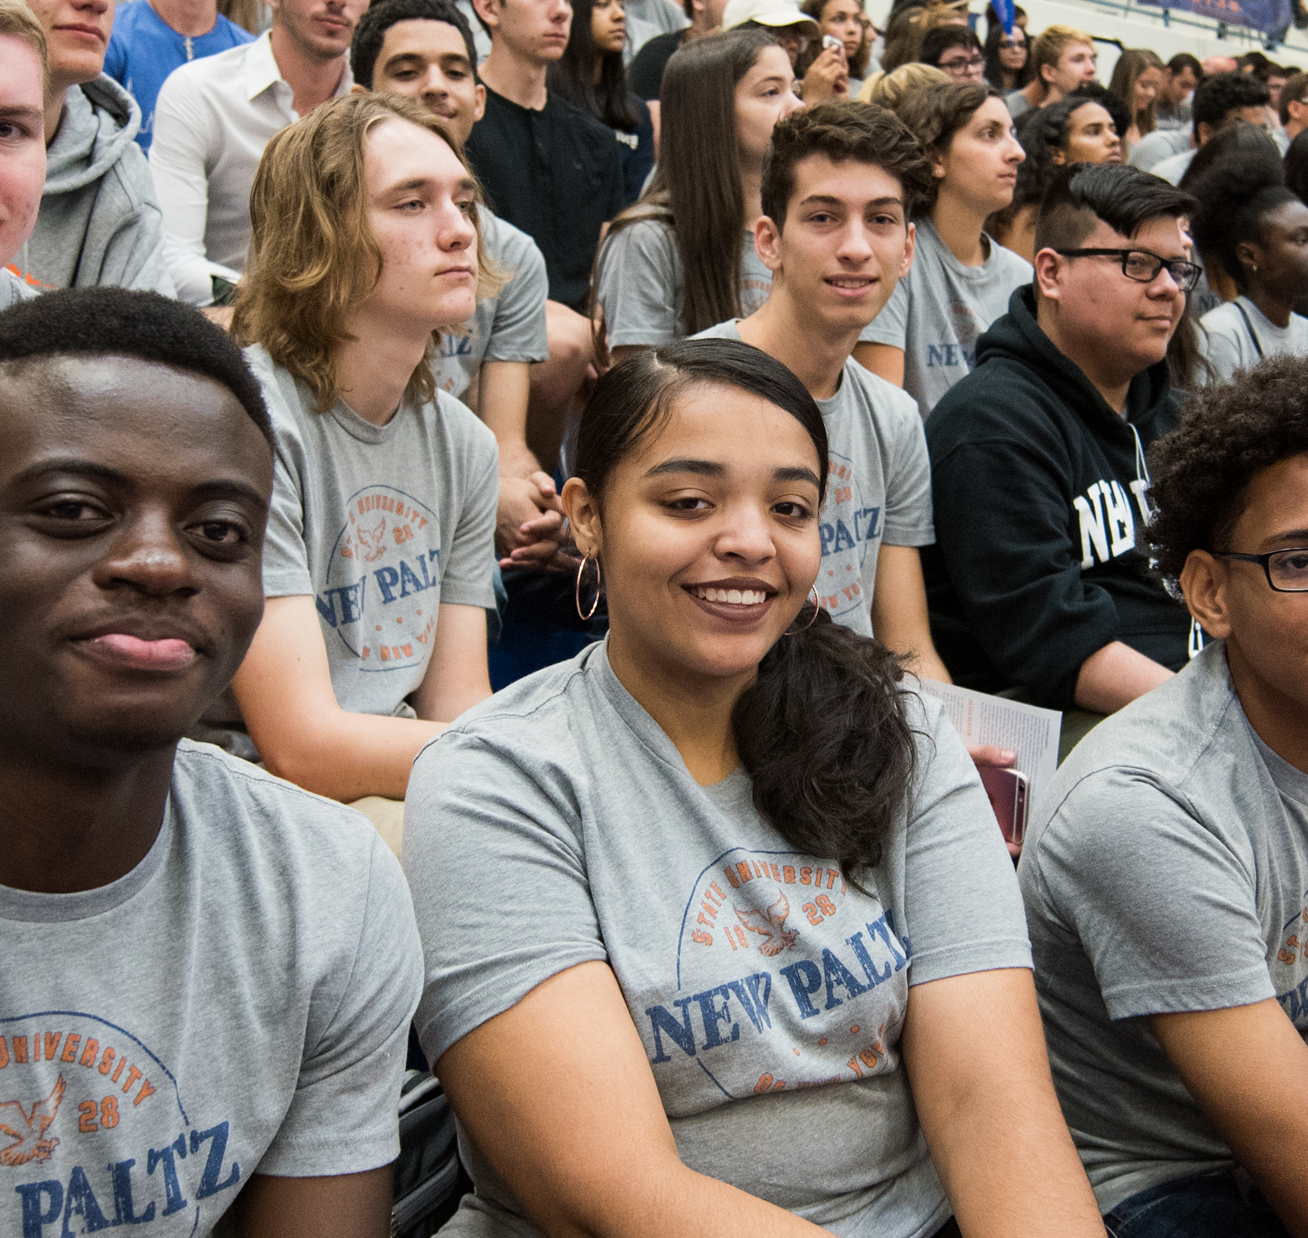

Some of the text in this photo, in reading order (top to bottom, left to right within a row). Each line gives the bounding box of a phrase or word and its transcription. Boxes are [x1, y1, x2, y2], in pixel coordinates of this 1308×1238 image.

[392, 523, 414, 545] 28
[692, 881, 727, 947] STATE
[724, 893, 837, 951] 18 28
[645, 909, 912, 1065] NEW PALT
[78, 1094, 121, 1134] 28
[15, 1120, 241, 1238] PALTZ
